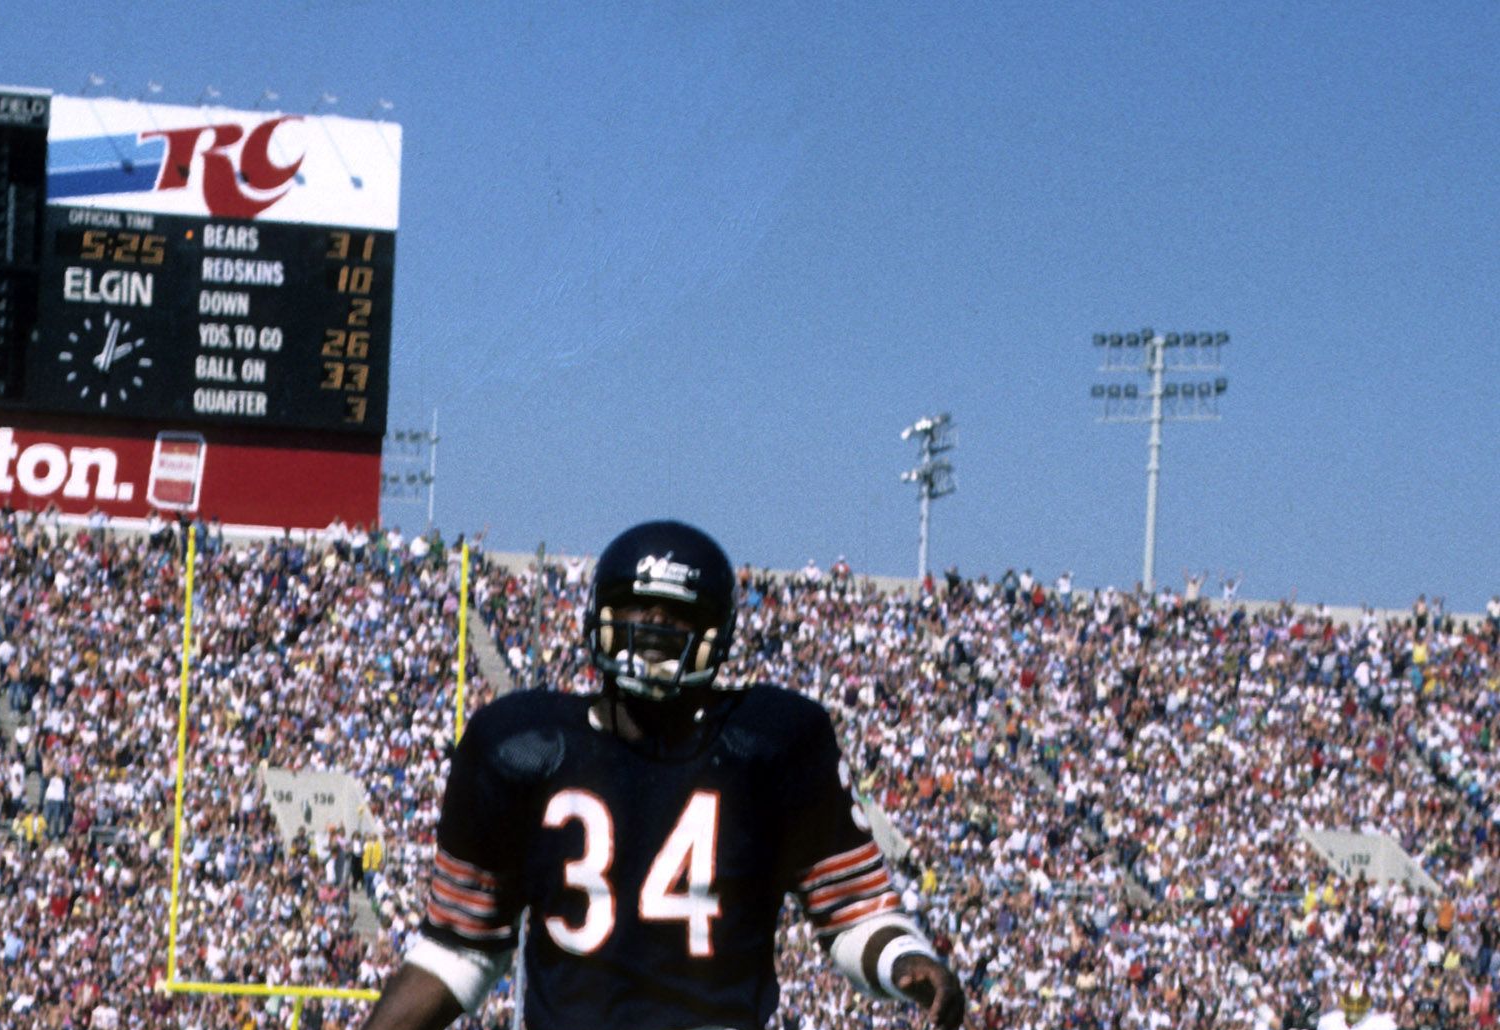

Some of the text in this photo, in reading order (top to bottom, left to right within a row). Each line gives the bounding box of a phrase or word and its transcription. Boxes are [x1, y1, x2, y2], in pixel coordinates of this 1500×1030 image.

[140, 115, 305, 219] RC
[68, 208, 155, 231] OFFICIAL TIME
[80, 230, 166, 265] 5:25
[203, 224, 259, 252] BEARS
[326, 231, 375, 263] 31
[64, 265, 153, 307] ELGIN
[202, 256, 285, 288] REDSKINS
[337, 265, 374, 295] 10
[199, 290, 249, 317] DOWN
[348, 298, 373, 328] 2
[198, 322, 283, 353] YDS. TO GO
[321, 328, 371, 360] 26
[195, 354, 267, 384] BALL ON
[320, 361, 369, 391] 33
[193, 386, 268, 417] QUARTER
[344, 396, 368, 425] 3
[542, 788, 722, 957] 34
